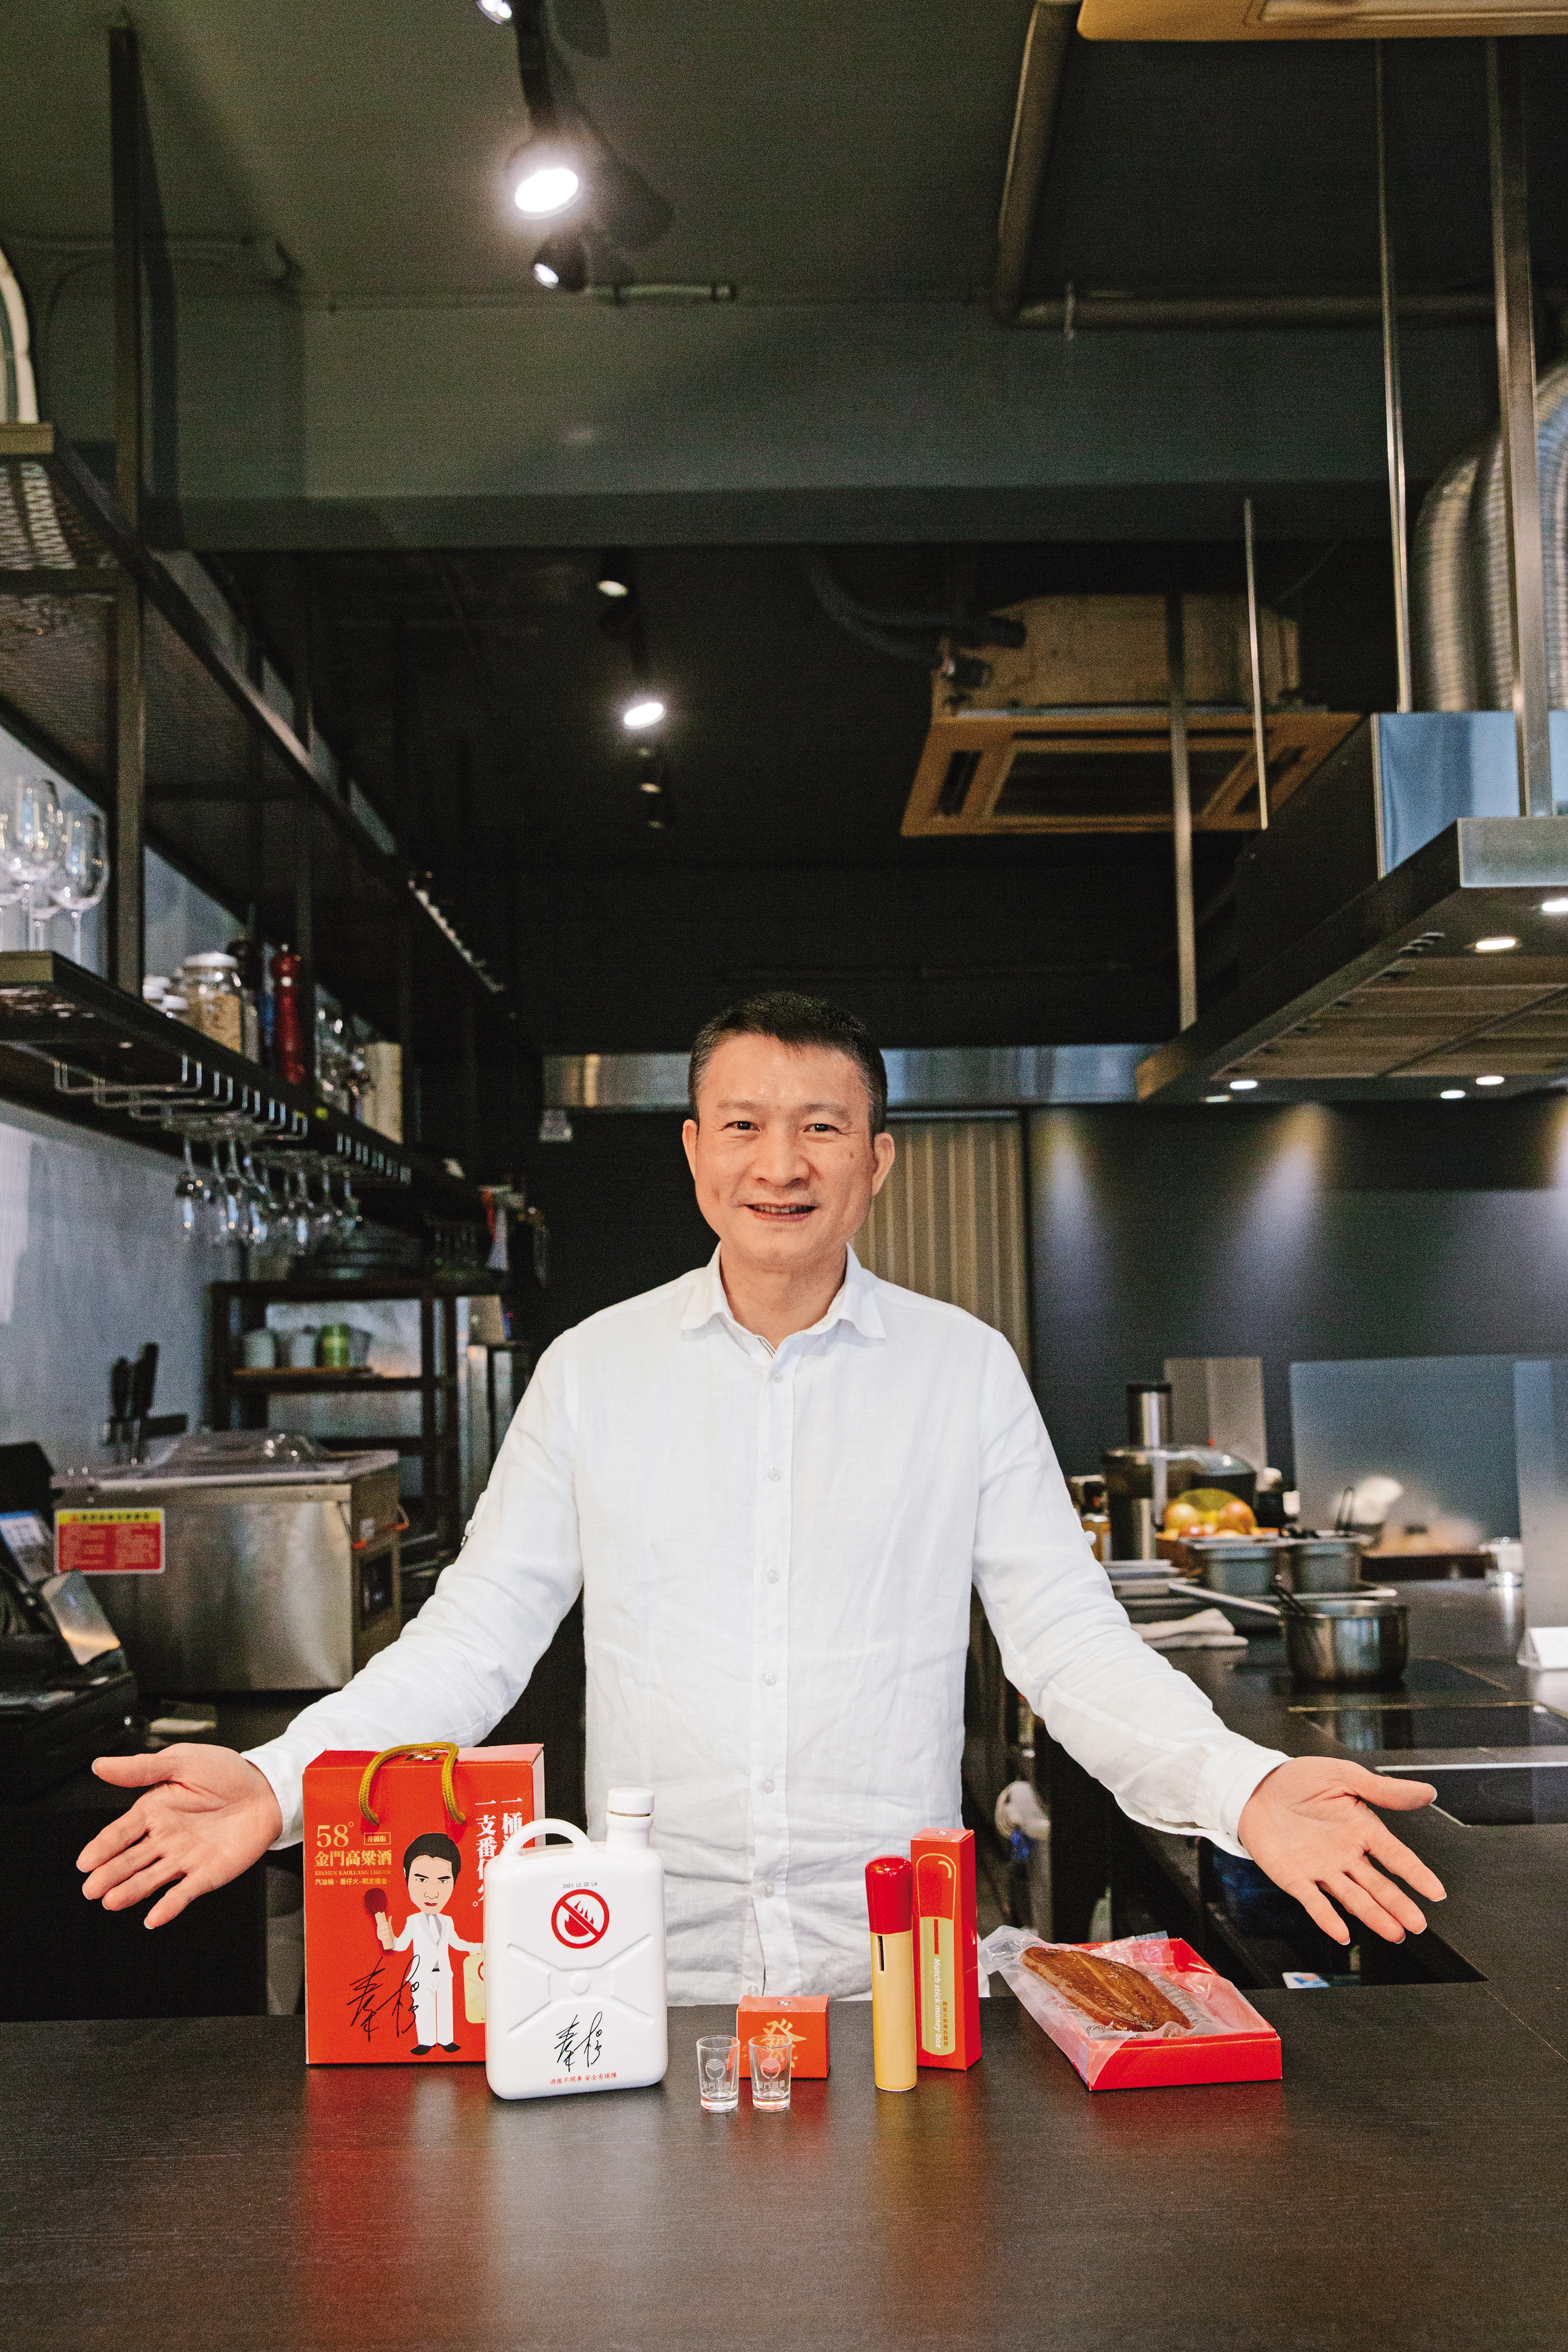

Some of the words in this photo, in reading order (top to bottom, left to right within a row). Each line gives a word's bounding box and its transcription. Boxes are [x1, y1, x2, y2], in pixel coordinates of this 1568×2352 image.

[316, 1821, 354, 1848] 58°
[314, 1850, 392, 1867] 金門高粱酒
[550, 2075, 582, 2084] 酒後不開車
[584, 2072, 617, 2081] 安全有保障
